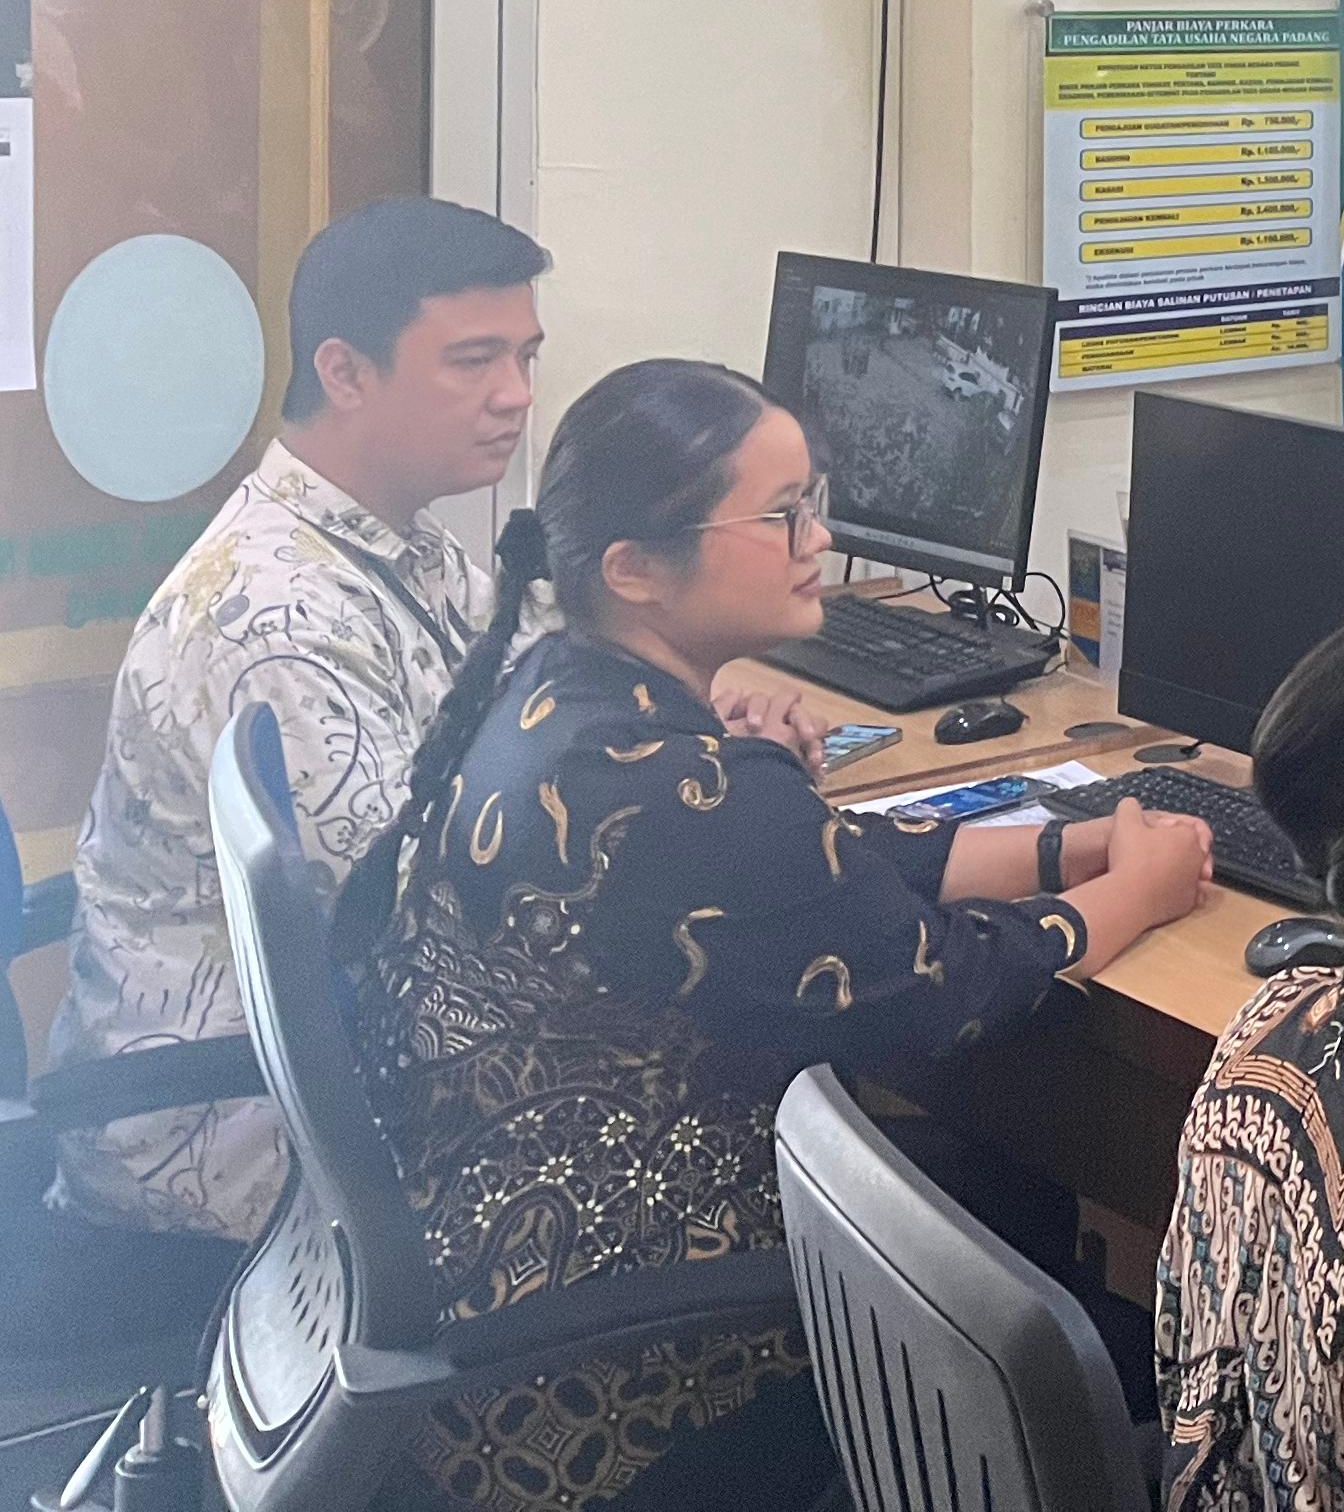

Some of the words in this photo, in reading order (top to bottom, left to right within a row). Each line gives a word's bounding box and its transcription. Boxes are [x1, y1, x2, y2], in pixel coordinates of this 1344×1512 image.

[1126, 20, 1174, 33] PANJAR
[1176, 20, 1213, 32] BIAYA
[1215, 19, 1274, 32] PERKARA
[1063, 34, 1148, 46] PENGADILAN
[1151, 33, 1181, 45] TATA
[1184, 32, 1226, 44] USAHA
[1229, 32, 1280, 43] NEGARA
[1282, 31, 1330, 42] PADANG
[1078, 301, 1123, 314] RINCIAN
[1125, 298, 1155, 311] BIAYA
[1157, 294, 1201, 308] SALINAN
[1203, 290, 1250, 304] PUTUSAN
[1256, 285, 1312, 299] PENETAPAN
